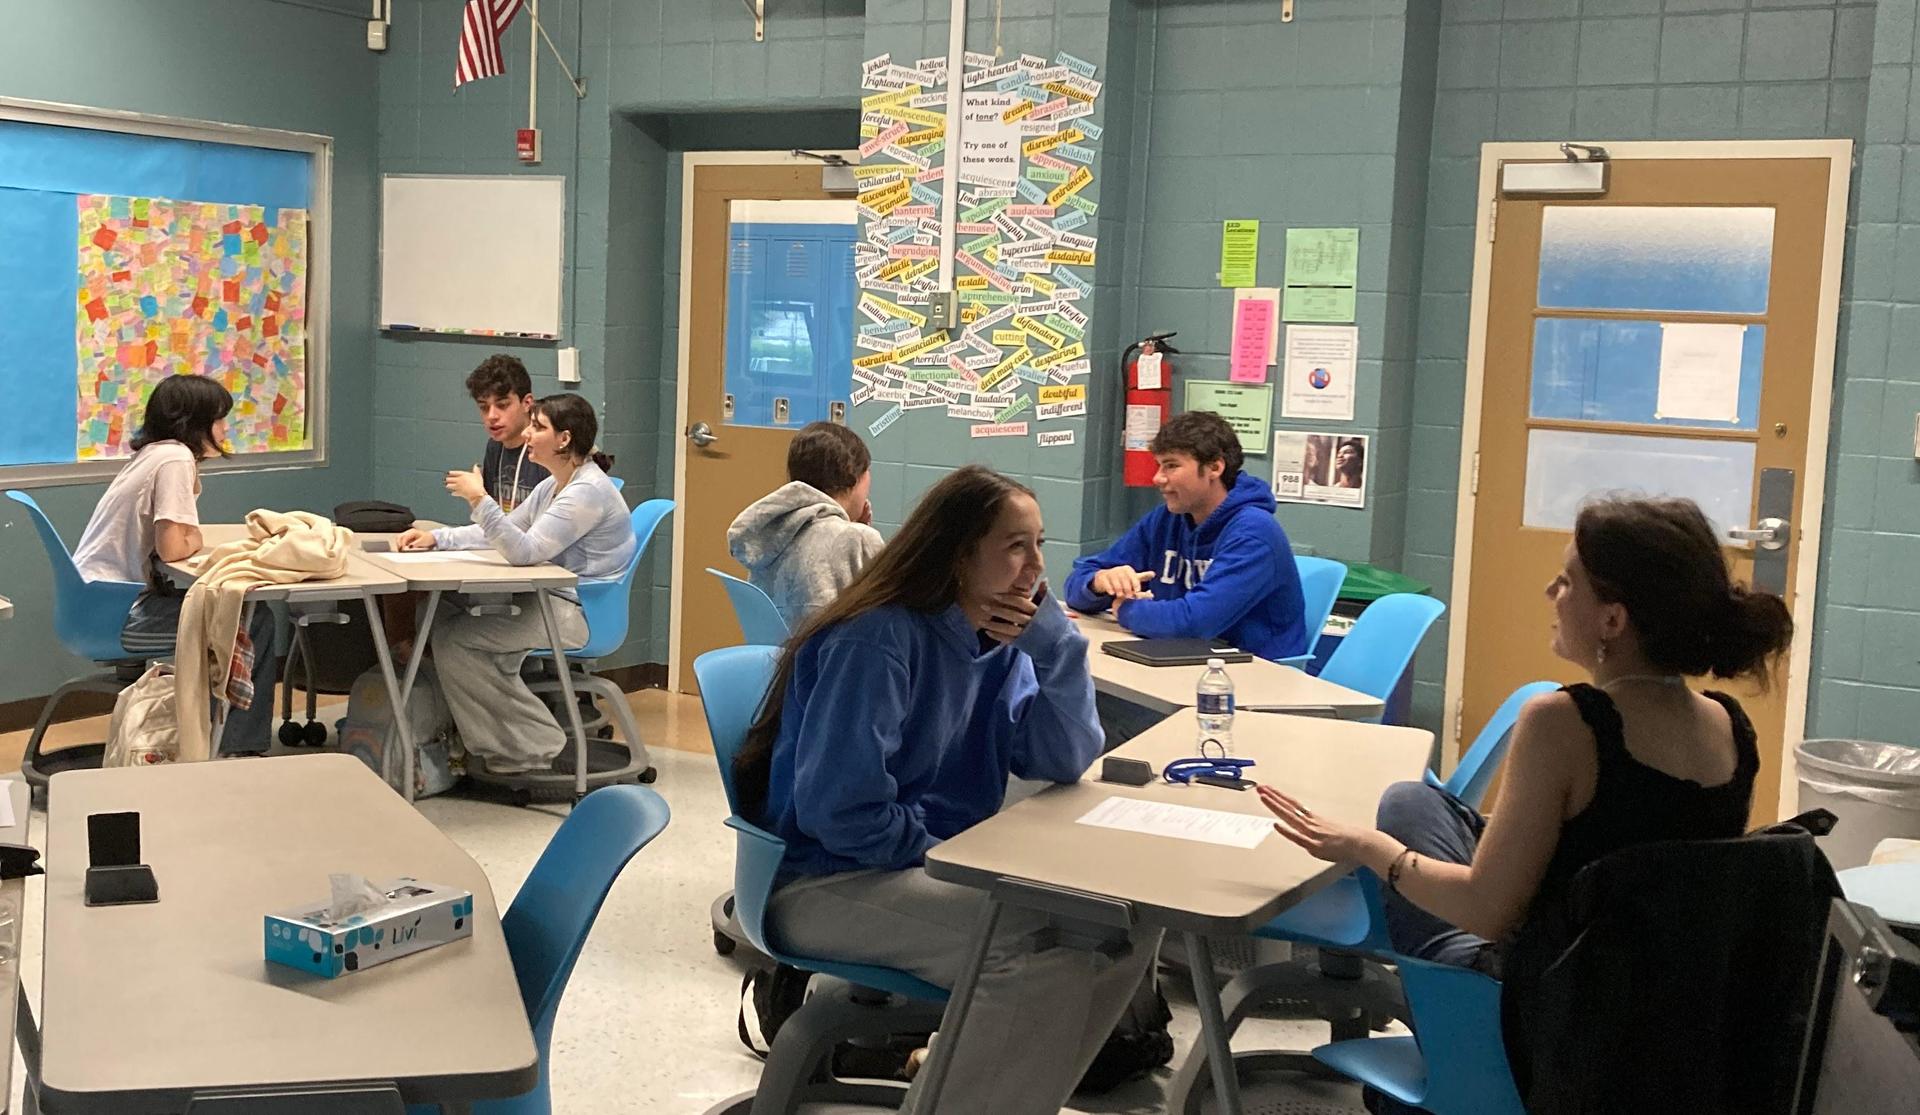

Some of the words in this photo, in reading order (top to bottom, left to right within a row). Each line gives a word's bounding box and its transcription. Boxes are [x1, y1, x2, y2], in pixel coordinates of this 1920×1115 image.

[920, 61, 944, 70] hollow
[965, 54, 994, 68] rallying
[1020, 57, 1045, 70] harsh
[1058, 53, 1093, 77] brusque
[891, 69, 932, 83] mysterious
[1001, 70, 1030, 90] candid
[1030, 68, 1067, 80] nostalgic
[864, 77, 904, 89] frightened
[1069, 76, 1098, 93] playful
[863, 85, 920, 108] contemptuous
[1021, 87, 1046, 100] blithe
[1046, 81, 1093, 103] enthusiastic
[914, 94, 947, 105] mocking
[966, 99, 988, 107] What
[991, 99, 1011, 107] kind
[884, 108, 943, 126] condescending
[976, 113, 998, 122] tone?
[1002, 100, 1034, 121] dreamy
[1052, 103, 1090, 122] peaceful
[862, 113, 890, 125] forceful
[862, 127, 877, 136] cold
[1021, 123, 1055, 133] resigned
[1073, 118, 1099, 137] bored
[897, 129, 944, 145] disparaging
[1026, 129, 1076, 153] disrespectful
[920, 140, 943, 157] angry
[964, 141, 979, 151] Try
[999, 141, 1008, 149] of
[887, 145, 929, 168] reproachful
[963, 155, 984, 163] these
[989, 155, 1015, 163] words.
[1057, 145, 1093, 163] childish
[854, 166, 917, 176] conversational
[1033, 153, 1076, 176] approving
[859, 173, 901, 189] exhilarated
[917, 169, 943, 182] ardent
[961, 173, 1012, 187] acquiescent
[1030, 172, 1064, 181] anxious
[861, 180, 905, 204] discouraged
[978, 188, 1014, 197] abrasive
[1017, 179, 1038, 201] bitter
[1052, 169, 1088, 203] entranced
[877, 192, 909, 213] dramatic
[911, 186, 941, 206] clipped
[959, 191, 980, 206] fond
[1065, 193, 1095, 213] aghast
[857, 205, 882, 221] solemn
[894, 207, 934, 216] bantering
[966, 197, 1008, 224] apologetic
[1010, 206, 1054, 215] audacious
[957, 224, 995, 233] bemused
[995, 213, 1022, 242] haughty
[1057, 214, 1086, 231] biting
[1026, 218, 1056, 242] taunting
[916, 236, 930, 244] wry
[968, 235, 999, 252] amused
[1060, 233, 1094, 249] languid
[892, 247, 938, 257] begrudging
[985, 249, 999, 262] coy
[1002, 240, 1051, 258] hypercritical
[1011, 258, 1048, 269] reflective
[1048, 251, 1092, 264] disdainful
[859, 259, 888, 280] facetious
[881, 259, 910, 279] didactic
[905, 259, 936, 281] detached
[957, 251, 1010, 290] argumentative
[996, 264, 1015, 279] calm
[865, 280, 909, 291] provocative
[959, 279, 987, 287] ecstatic
[1025, 275, 1054, 291] cynical
[1057, 266, 1090, 294] boastful
[1012, 283, 1031, 294] grim
[1055, 290, 1077, 300] stern
[898, 293, 930, 305] eulogisti
[962, 293, 1018, 305] apprehensive
[863, 302, 889, 324] exultant
[1018, 301, 1055, 313] irreverent
[1060, 303, 1084, 324] gleeful
[962, 311, 976, 322] dry
[971, 305, 1015, 332] reminiscing
[864, 321, 908, 335] benevolent
[1017, 316, 1058, 345] defamatory
[1050, 317, 1083, 338] adoring
[861, 336, 894, 350] poignant
[897, 329, 919, 343] proud
[995, 333, 1024, 344] cutting
[899, 333, 945, 358] denunciatory
[945, 340, 967, 352] smug
[914, 354, 949, 366] horrified
[967, 355, 998, 367] shocked
[1035, 346, 1076, 368] despairing
[854, 368, 888, 388] indulgent
[885, 365, 907, 379] happy
[910, 371, 959, 380] affectionate
[1014, 367, 1047, 383] cavalier
[1048, 367, 1068, 382] glum
[905, 381, 925, 393] tense
[947, 381, 978, 391] satirical
[1000, 375, 1018, 391] wary
[853, 384, 876, 404] fearful
[877, 390, 907, 400] acerbic
[927, 382, 958, 401] guarded
[1042, 389, 1078, 399] doubtful
[975, 394, 1013, 406] laudatory
[948, 408, 994, 420] melancholy
[1041, 402, 1082, 416] indifferent
[871, 408, 903, 434] bristling
[975, 425, 1025, 436] acquiescent
[1040, 433, 1072, 445] flippant
[1282, 475, 1300, 483] 988
